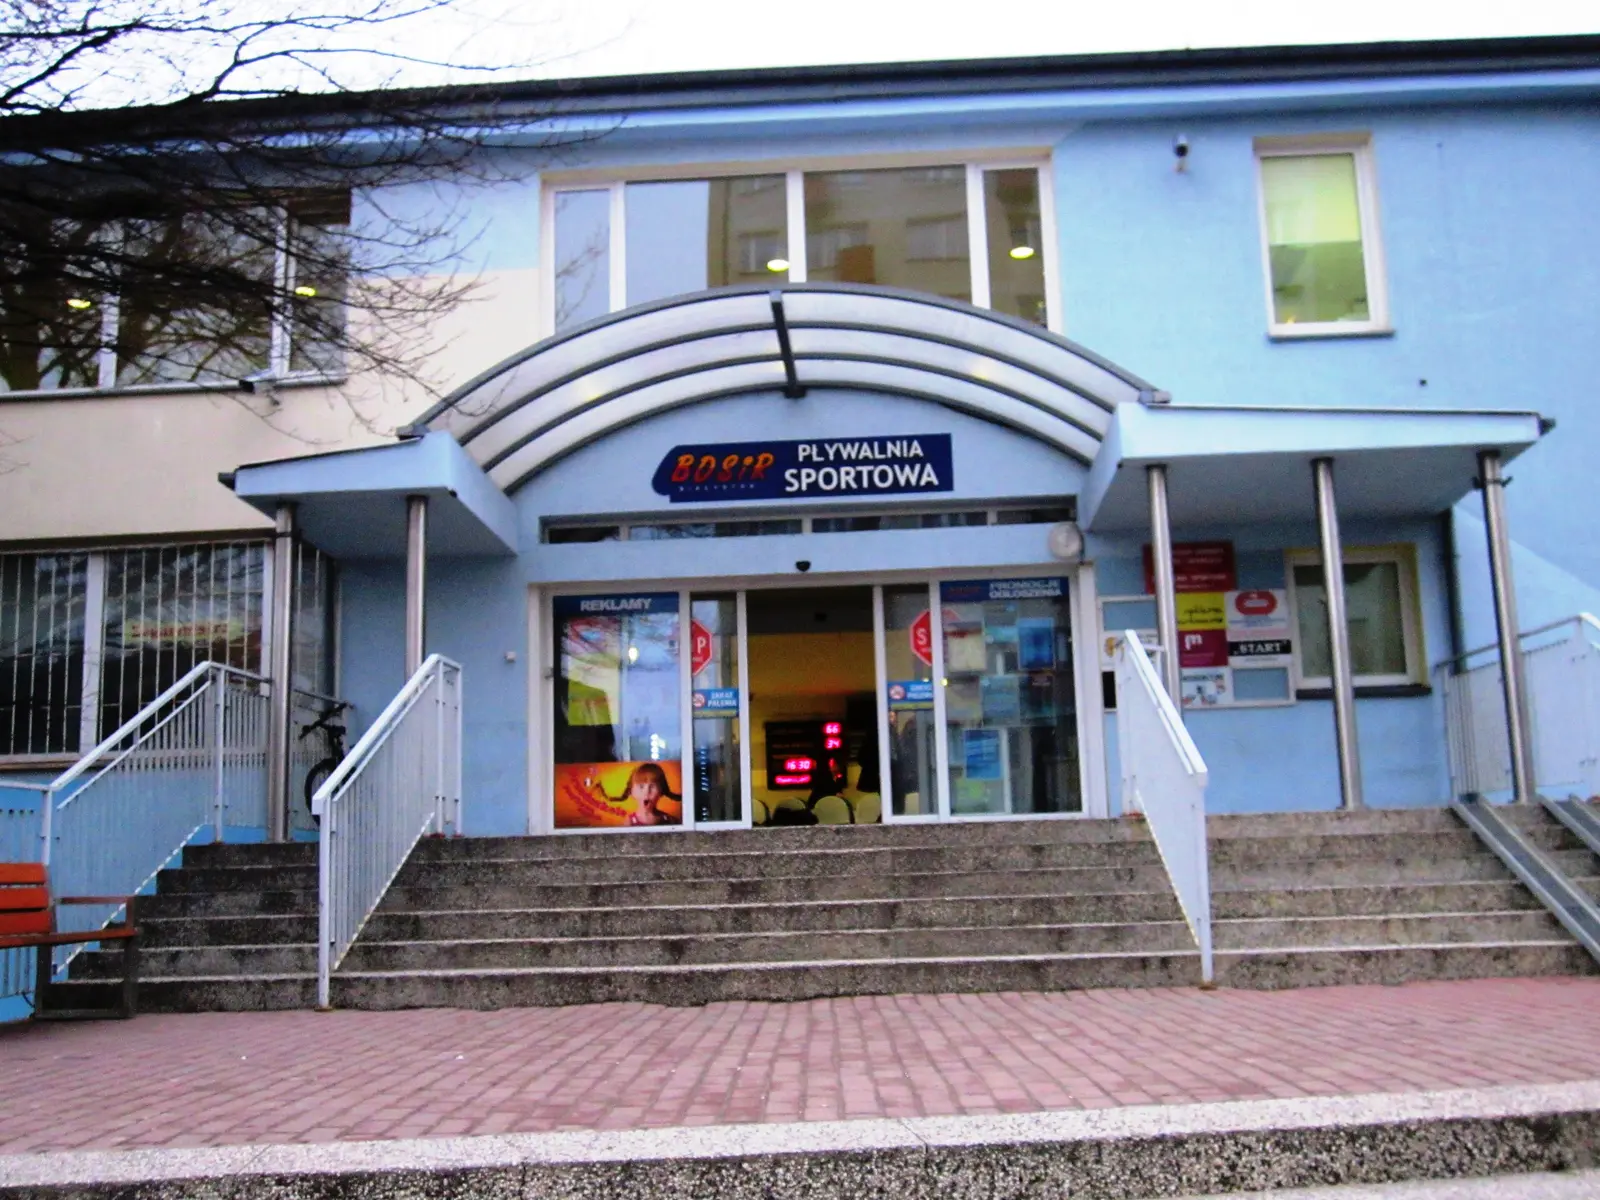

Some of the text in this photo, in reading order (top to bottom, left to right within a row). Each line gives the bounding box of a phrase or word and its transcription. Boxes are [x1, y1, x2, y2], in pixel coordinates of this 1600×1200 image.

[798, 440, 924, 462] PŁYWALNIA
[784, 463, 939, 493] SPORTOWA
[580, 598, 652, 612] REKLAMY
